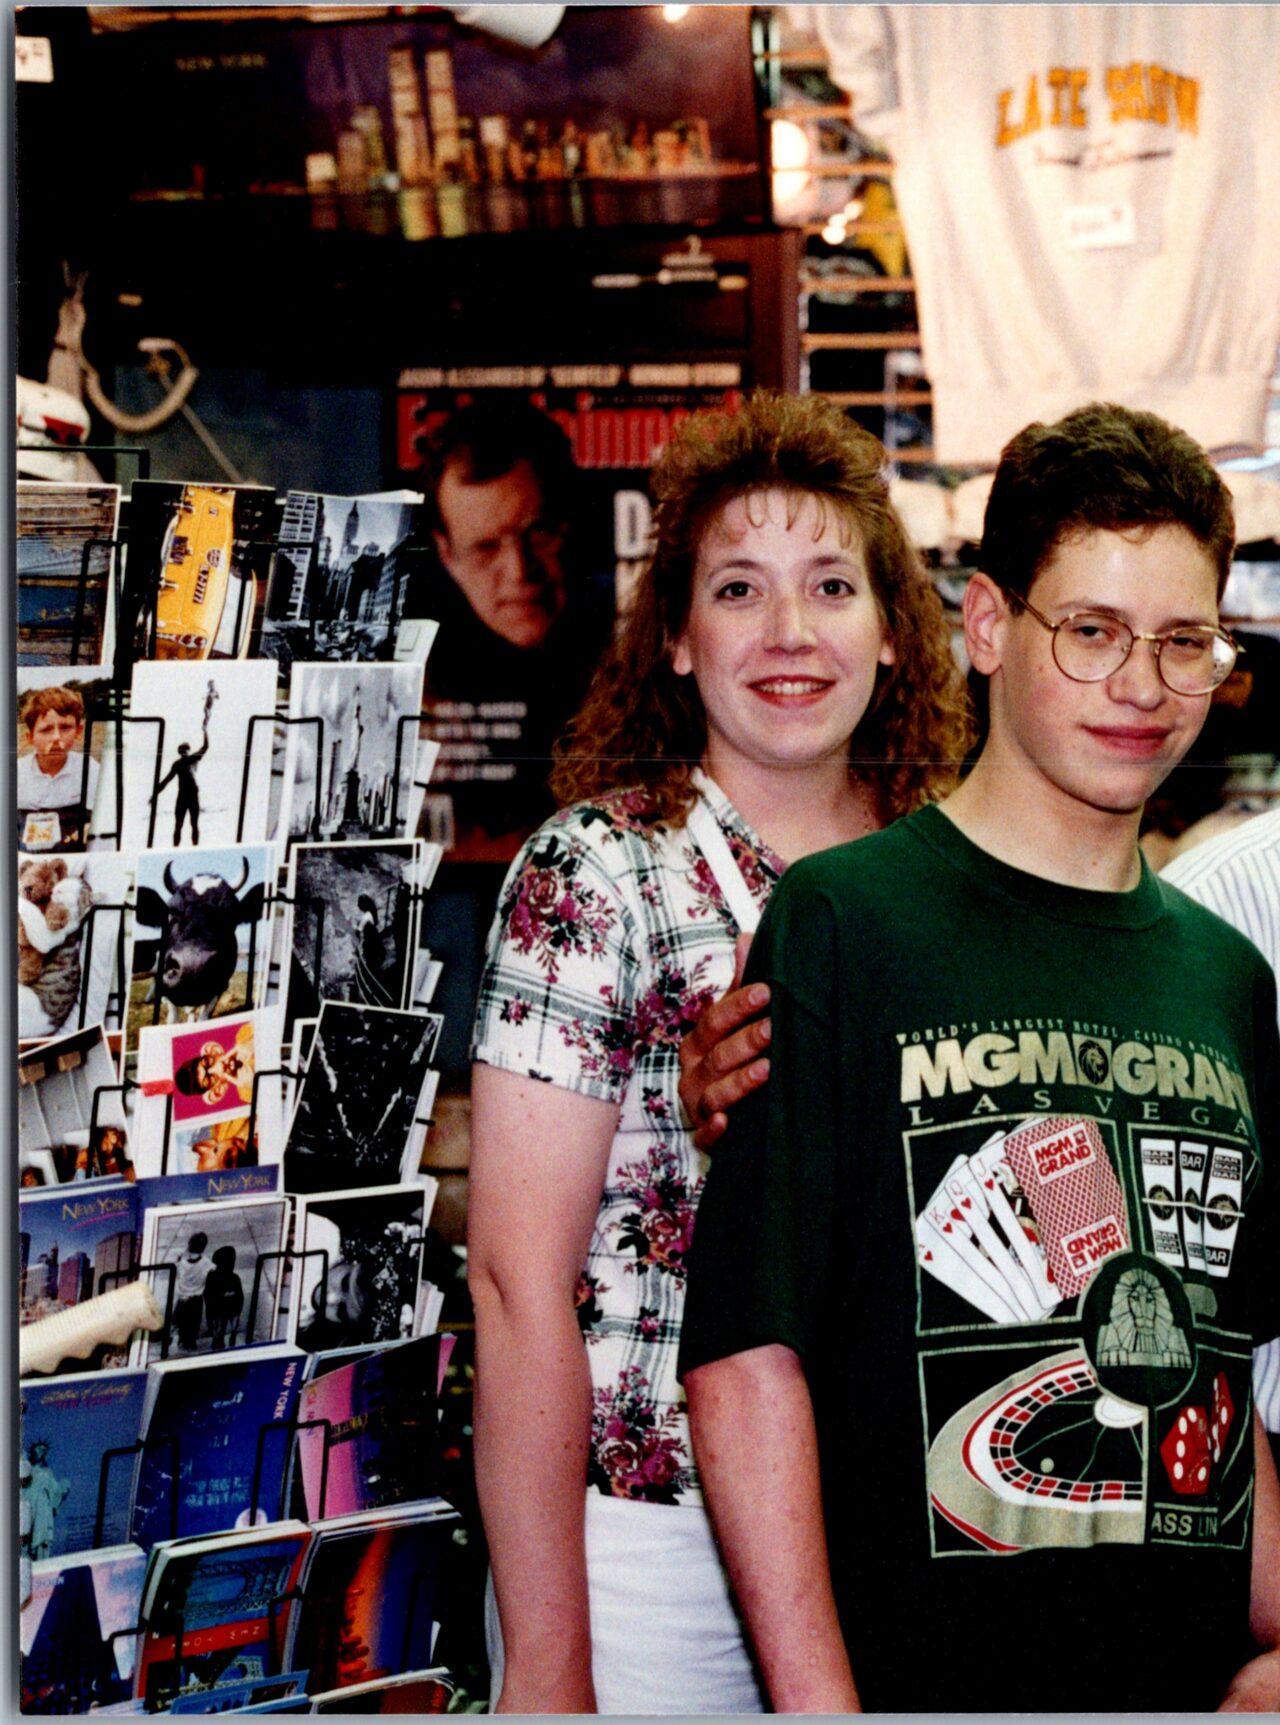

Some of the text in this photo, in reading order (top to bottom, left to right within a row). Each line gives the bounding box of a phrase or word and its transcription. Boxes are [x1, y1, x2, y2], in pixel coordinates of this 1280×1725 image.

[995, 60, 1201, 148] LATE SHOW
[896, 1022, 979, 1045] WORLD'S
[991, 1018, 1064, 1032] LARGEST
[1134, 1029, 1182, 1048] CASINO
[901, 1031, 1080, 1103] MGM
[910, 1090, 1053, 1127] LAS
[1035, 1136, 1074, 1164] MGM
[1038, 1144, 1092, 1177] GRAND
[1181, 1153, 1202, 1169] BAR
[208, 1174, 270, 1195] NEW YORK
[62, 1198, 130, 1221] NEW YORK
[1066, 1222, 1119, 1254] GRAND
[1087, 1235, 1123, 1262] MGM
[1206, 1249, 1227, 1263] BAR
[273, 1362, 297, 1419] NEW YORK
[1151, 1511, 1194, 1537] ASS
